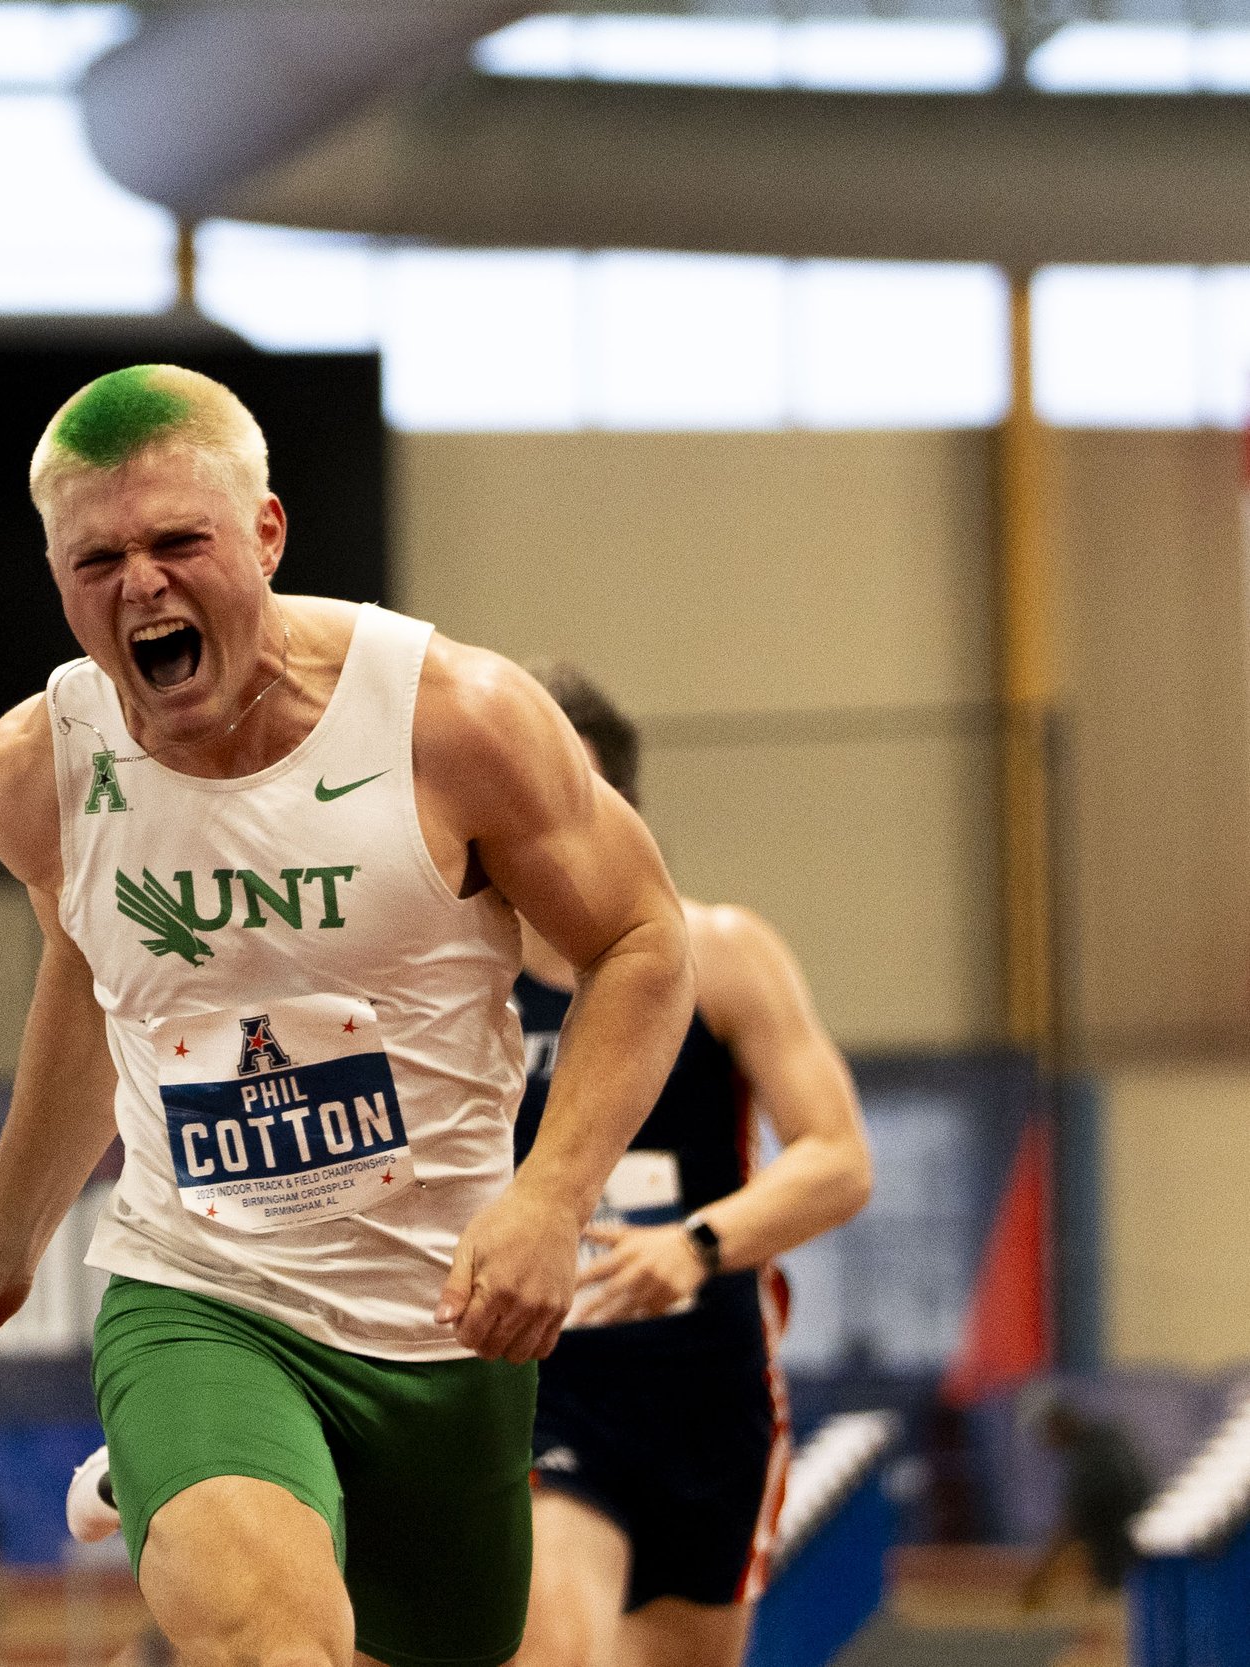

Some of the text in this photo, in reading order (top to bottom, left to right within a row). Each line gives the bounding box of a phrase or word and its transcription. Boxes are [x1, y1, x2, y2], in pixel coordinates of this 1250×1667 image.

[173, 865, 355, 930] UNT
[240, 1076, 308, 1112] PHIL
[181, 1092, 394, 1178] COTTON
[195, 1153, 396, 1200] 2025 INDOOR TRACK & FIELD CHAMPIONSHIPS
[242, 1178, 355, 1208] BIRMINGHAM CROSSPLEX
[327, 1196, 339, 1206] AL
